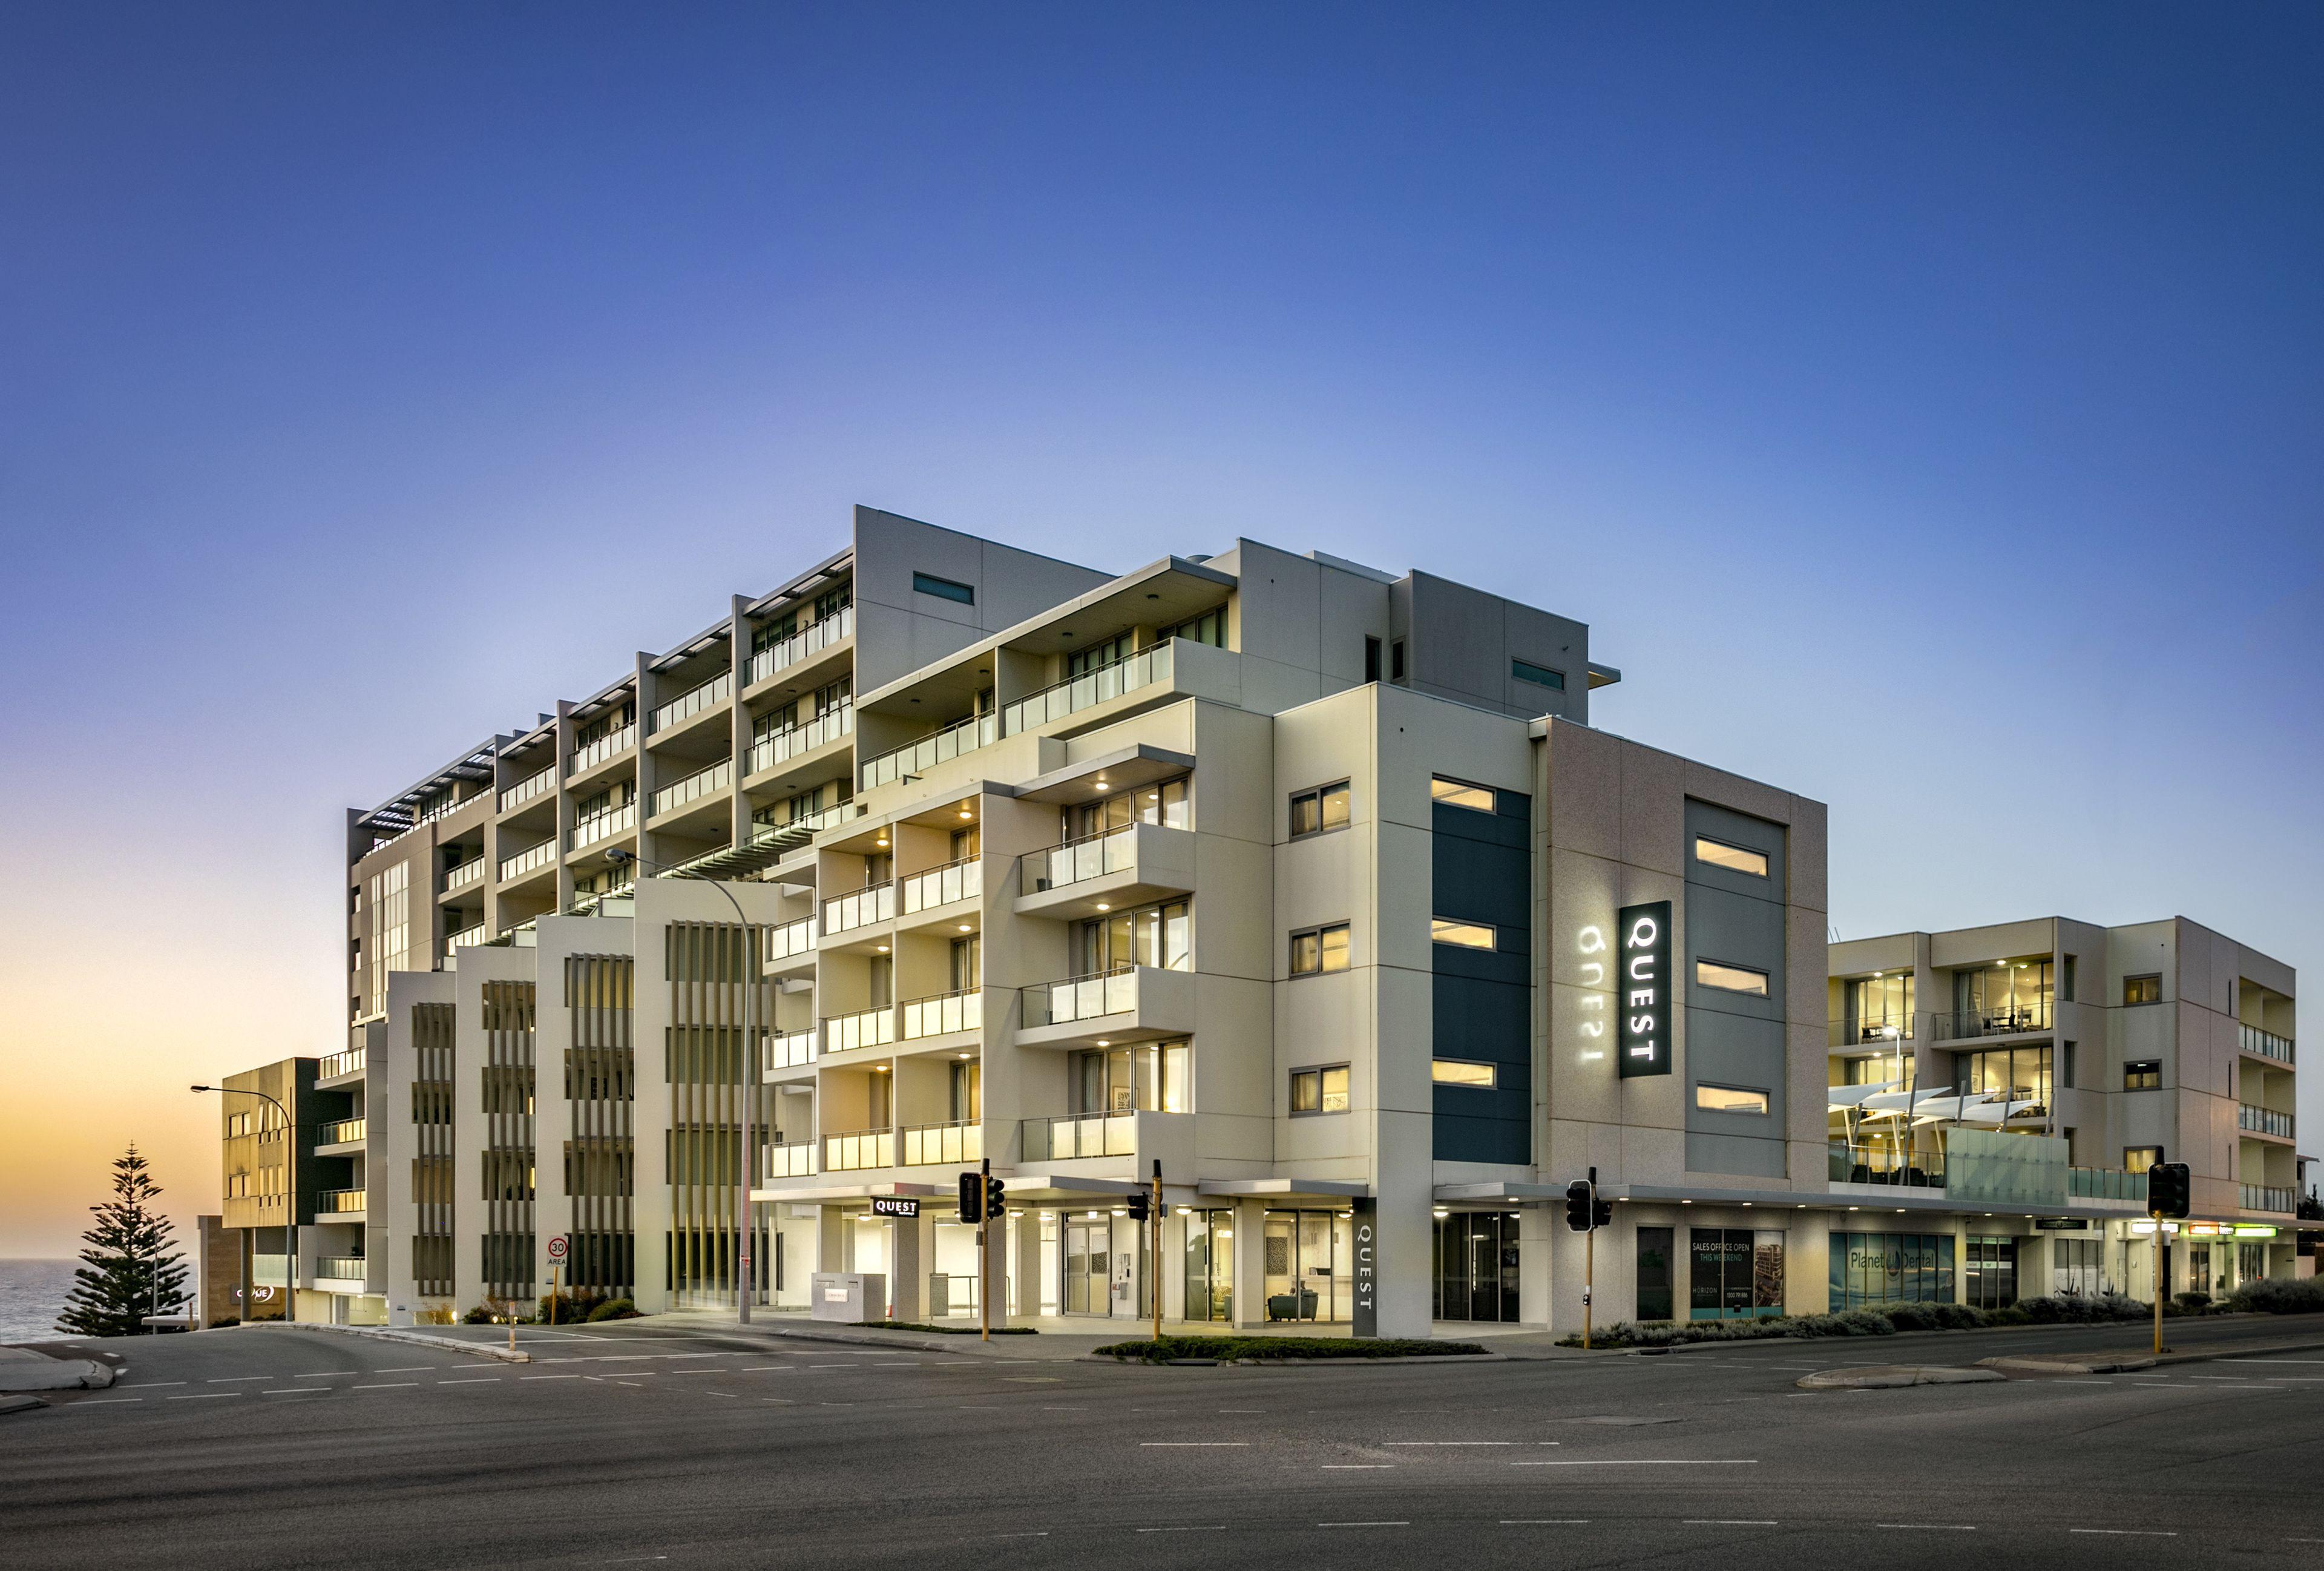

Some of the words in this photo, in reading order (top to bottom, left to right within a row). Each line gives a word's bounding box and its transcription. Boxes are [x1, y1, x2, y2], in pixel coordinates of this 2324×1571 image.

[1628, 917, 1656, 1061] QUEST
[876, 1200, 917, 1212] QUEST
[1357, 1225, 1371, 1309] QUEST
[1851, 1252, 1884, 1268] Planet
